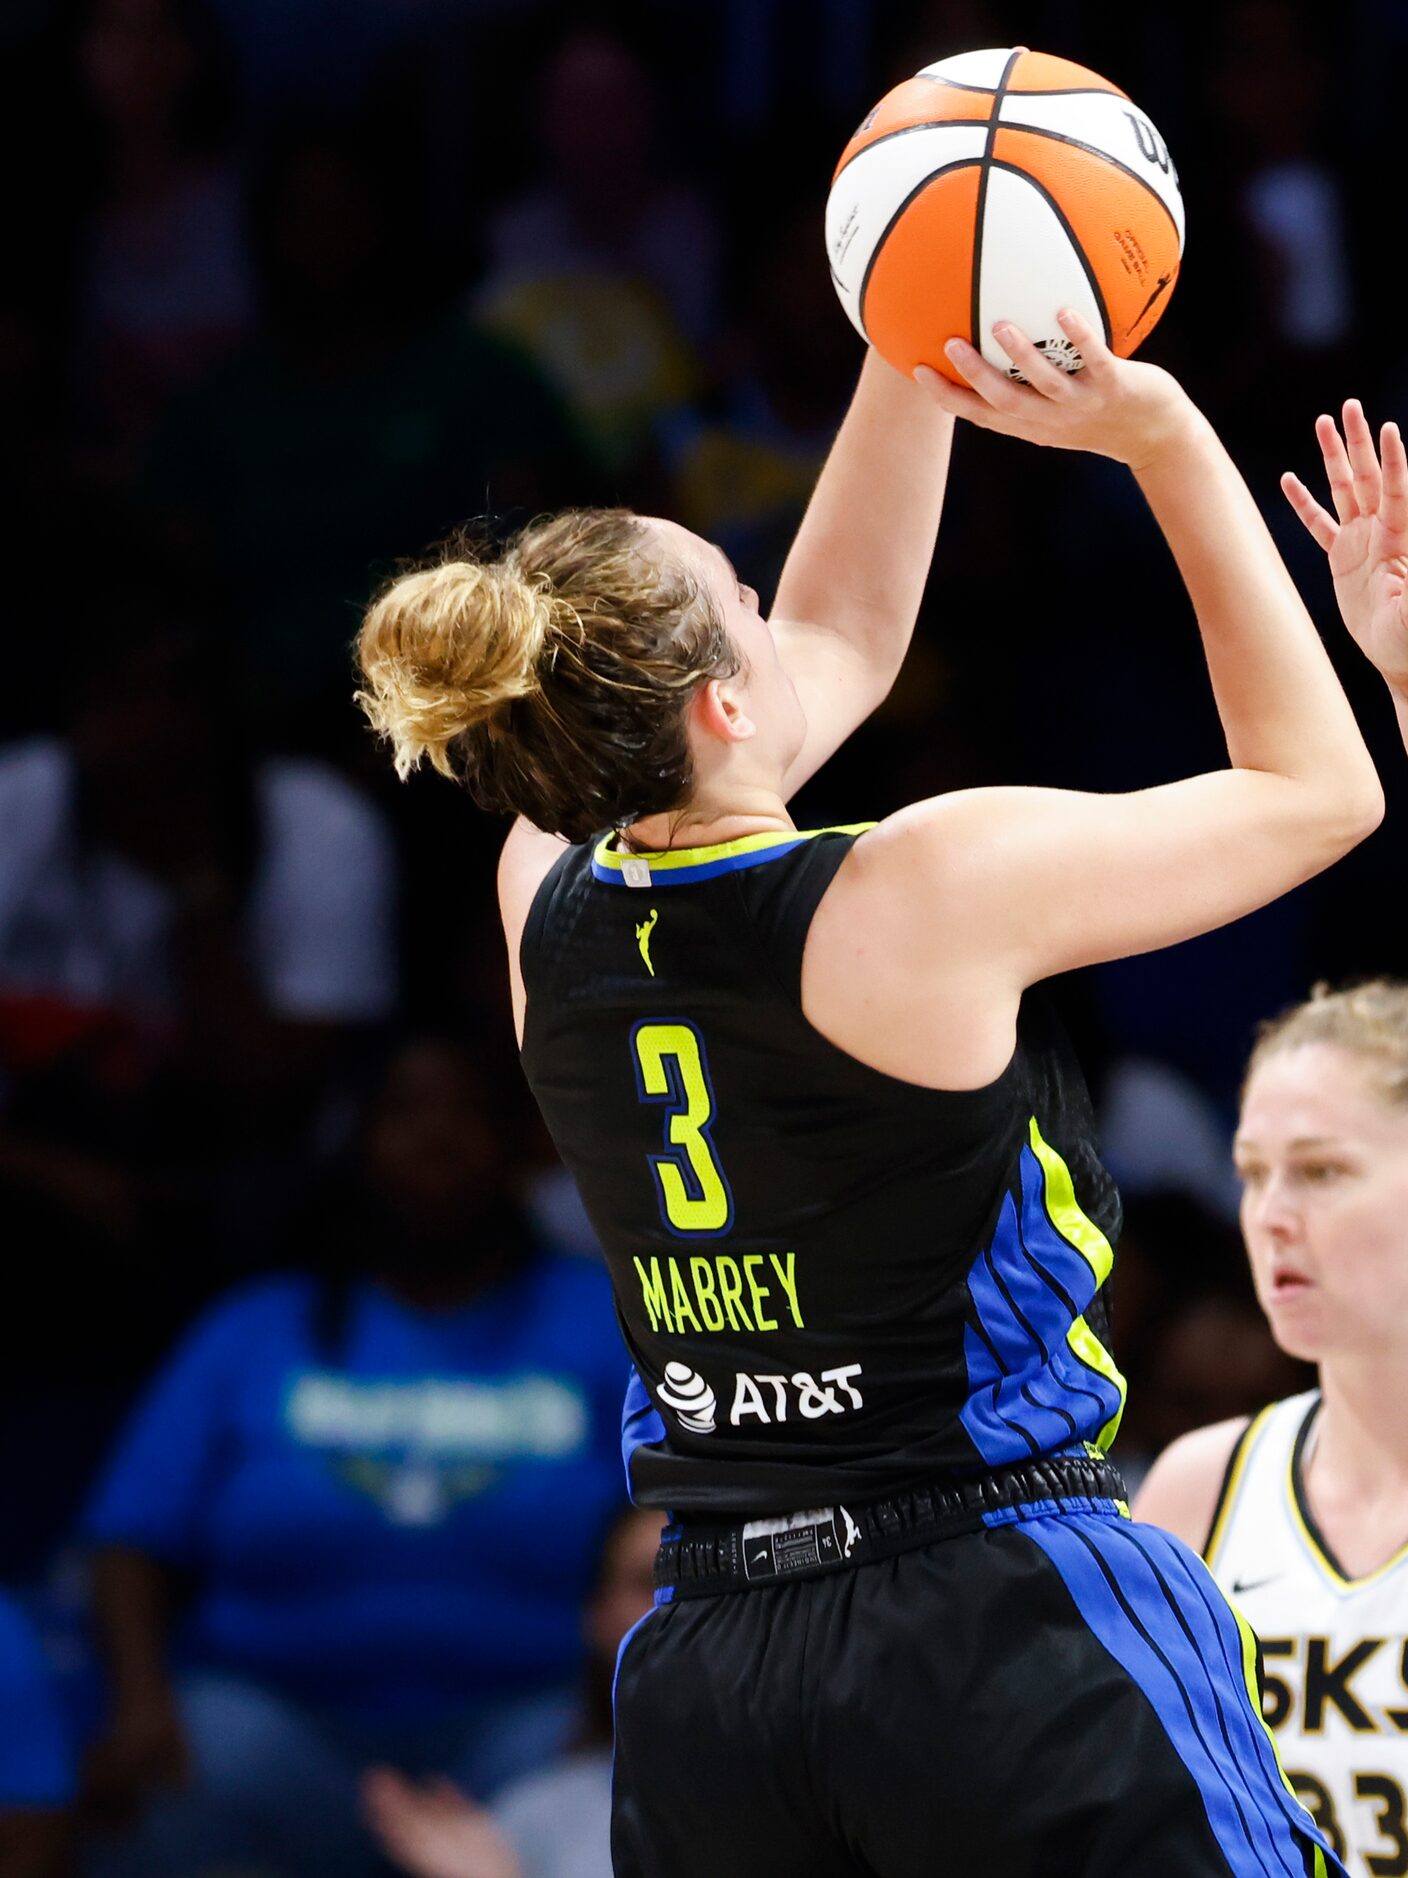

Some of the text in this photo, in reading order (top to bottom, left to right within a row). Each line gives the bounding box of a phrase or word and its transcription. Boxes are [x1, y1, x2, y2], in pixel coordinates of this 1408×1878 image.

[629, 1016, 735, 1238] 3
[632, 1252, 804, 1334] MABREY
[729, 1363, 863, 1426] AT&T
